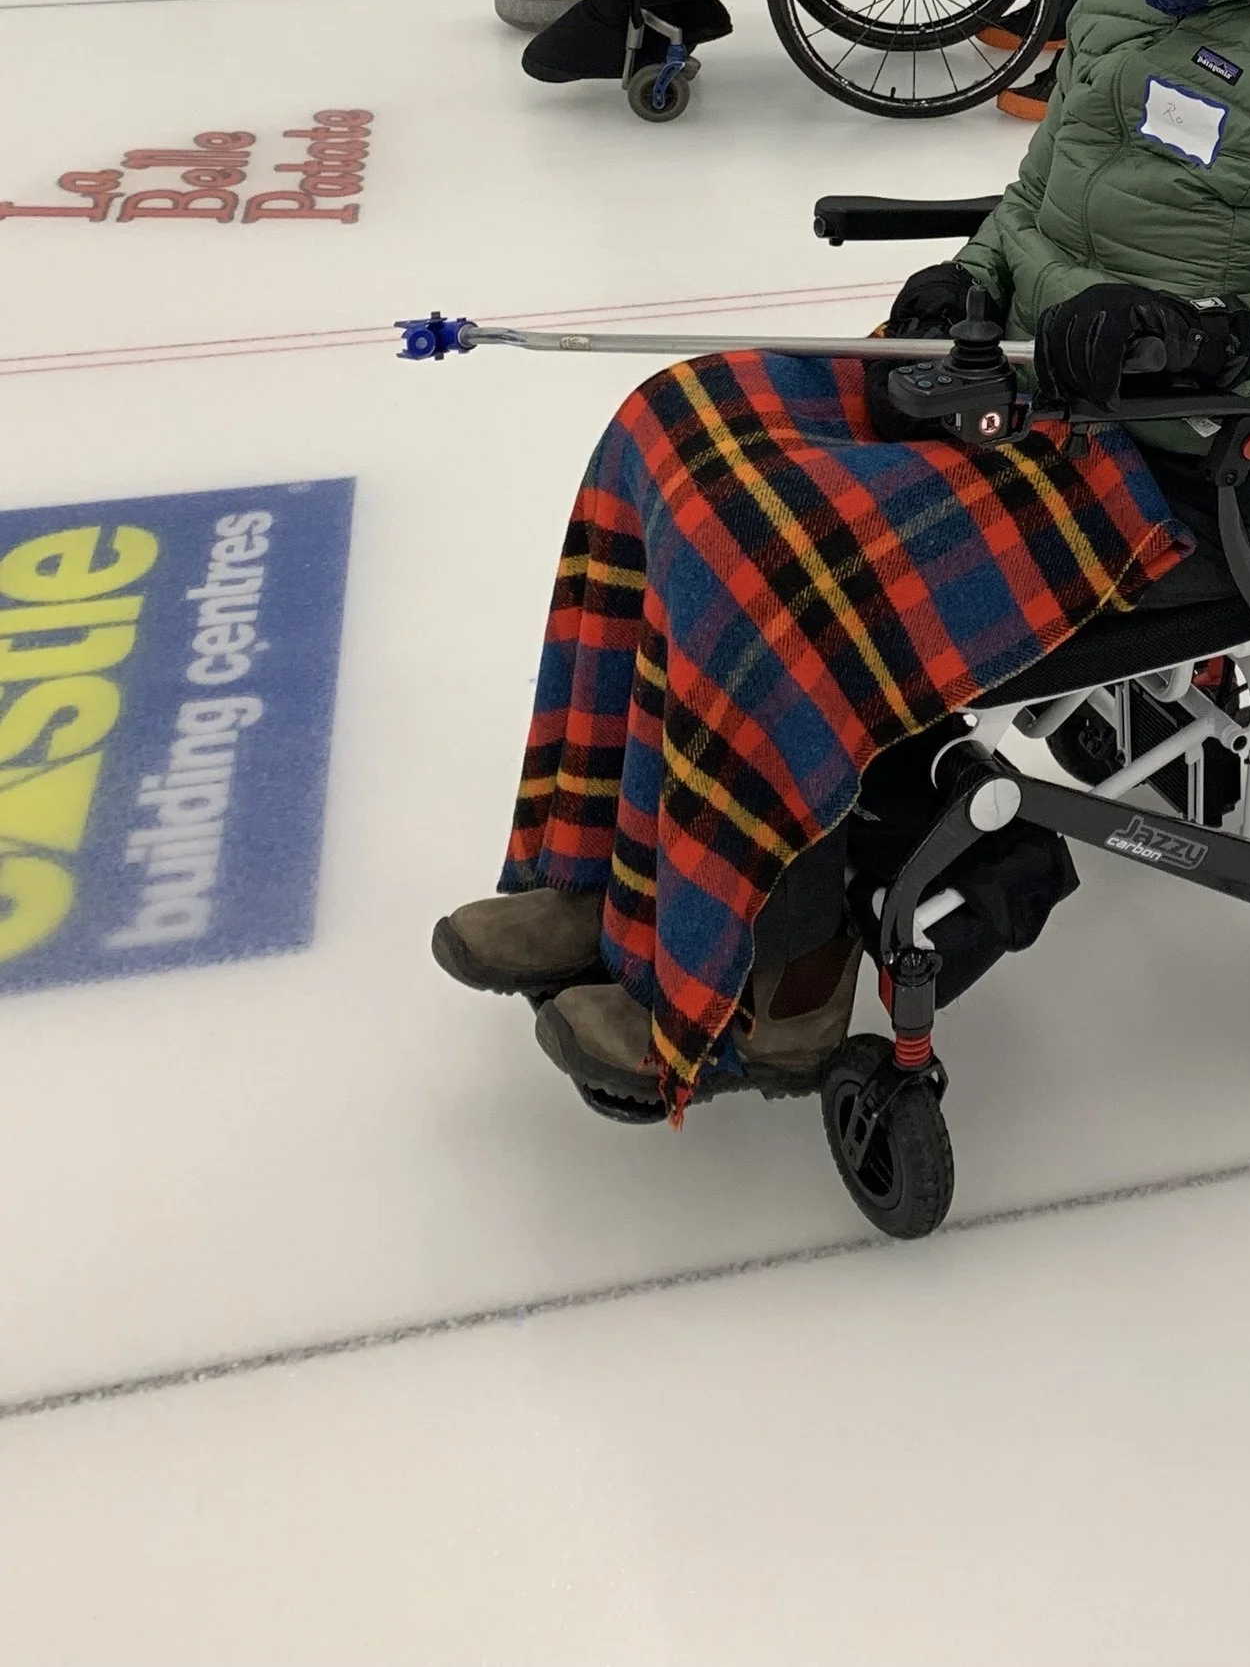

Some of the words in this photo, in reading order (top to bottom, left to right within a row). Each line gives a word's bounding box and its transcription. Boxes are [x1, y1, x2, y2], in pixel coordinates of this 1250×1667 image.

[1196, 55, 1232, 80] patagonia
[116, 130, 257, 224] Belle
[105, 695, 266, 951] building
[186, 509, 274, 686] centres
[1106, 836, 1163, 862] carbon
